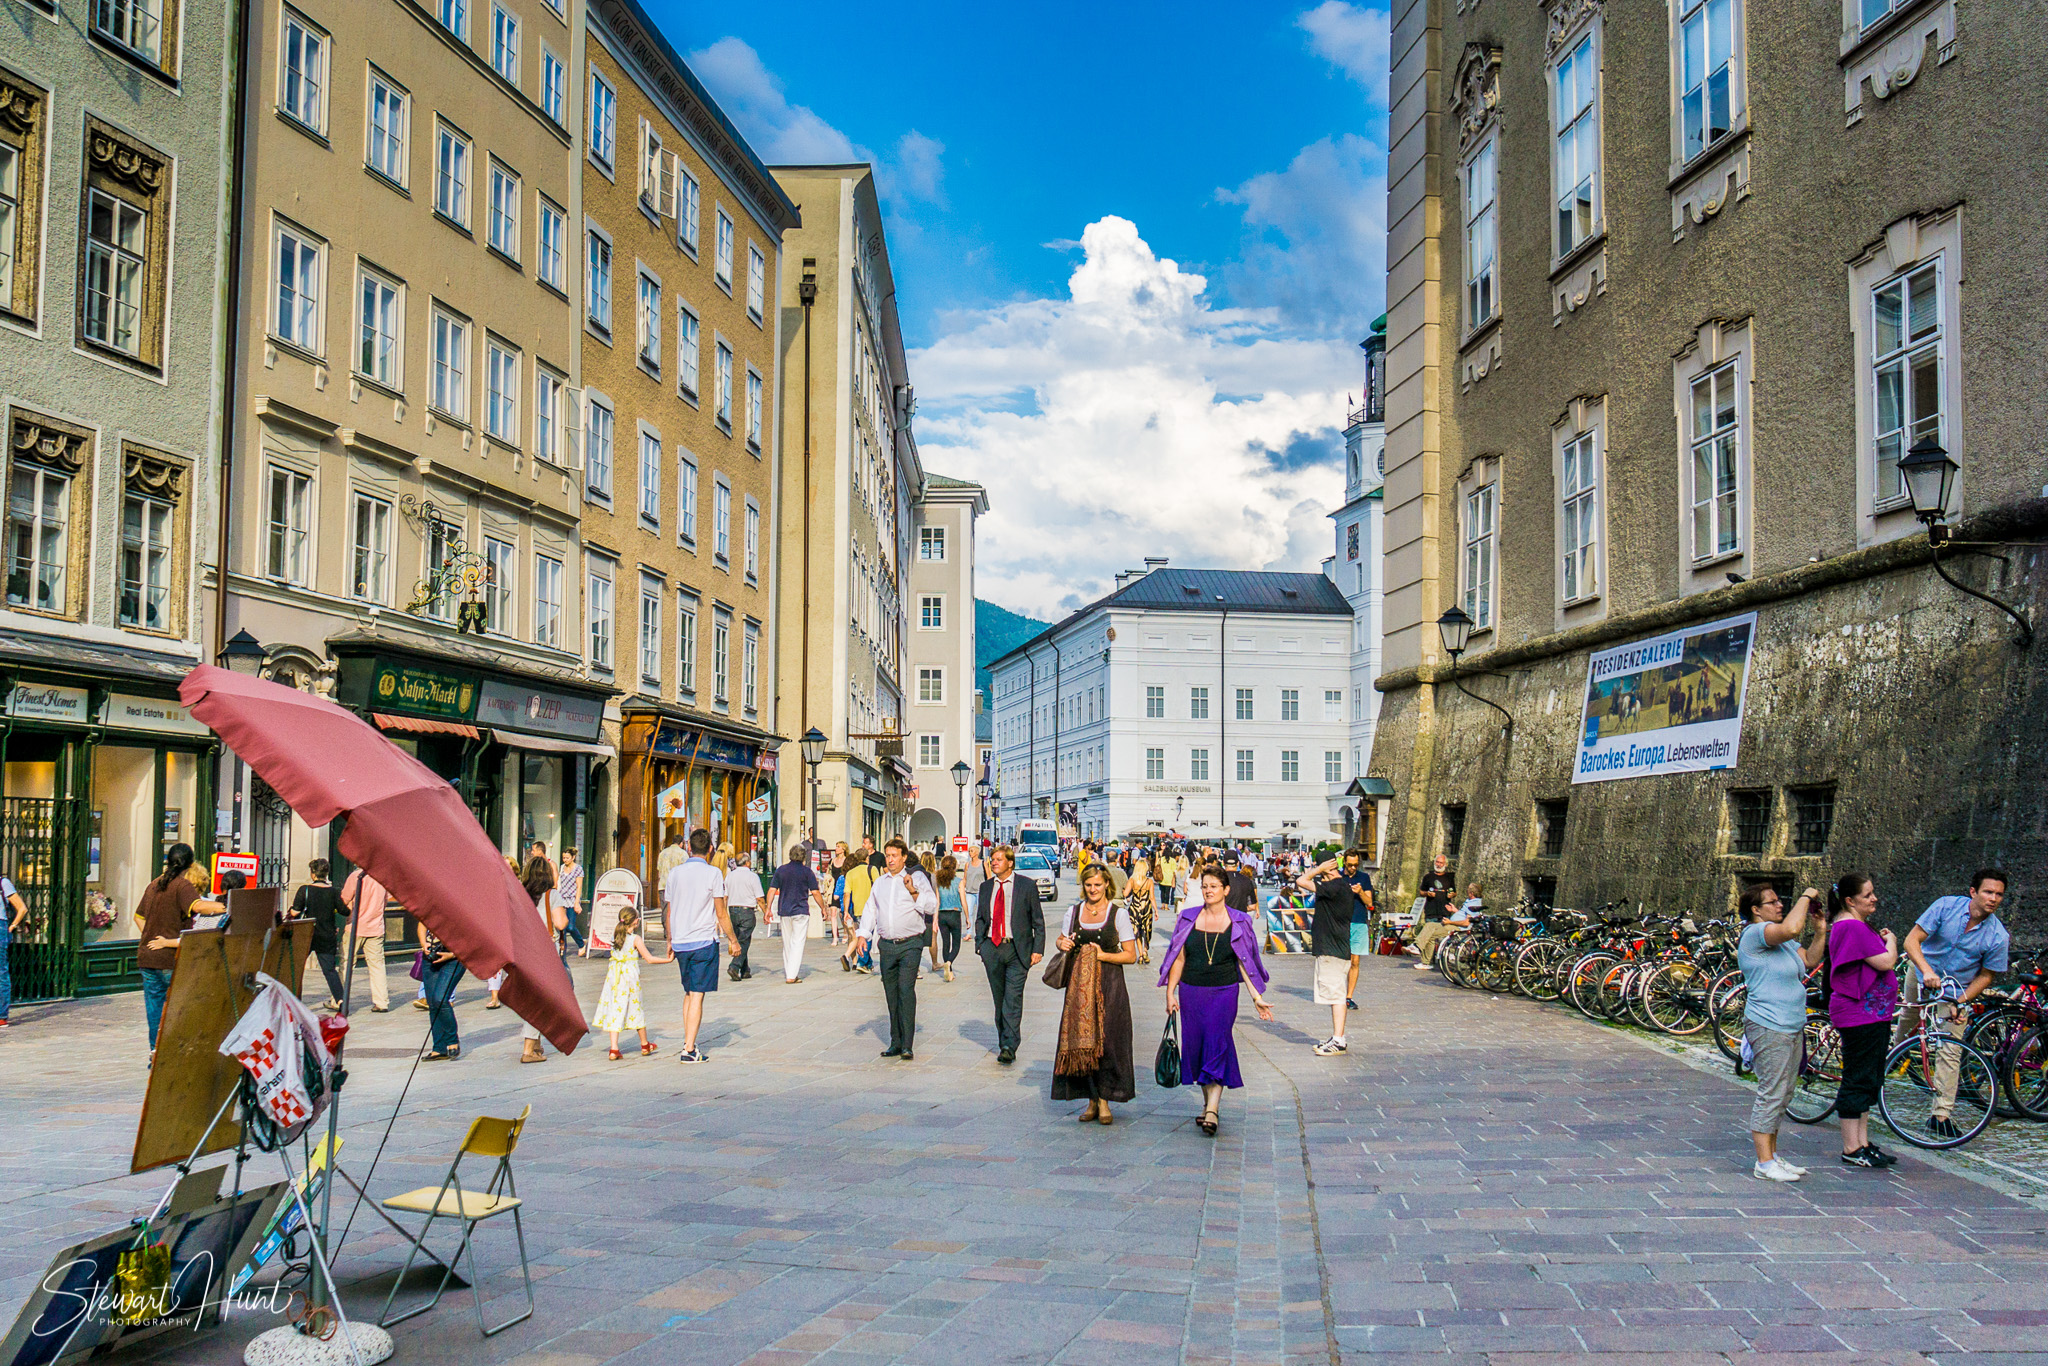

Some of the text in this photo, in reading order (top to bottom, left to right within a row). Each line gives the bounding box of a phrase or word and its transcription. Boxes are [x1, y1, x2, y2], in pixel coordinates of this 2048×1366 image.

[1597, 638, 1683, 676] RESIDENZGALERIE
[17, 685, 77, 709] Finest Homes
[126, 706, 164, 719] Real Estate
[1580, 738, 1730, 774] Barockes Europa. Lebenswelten
[1144, 785, 1178, 793] SALZBURG
